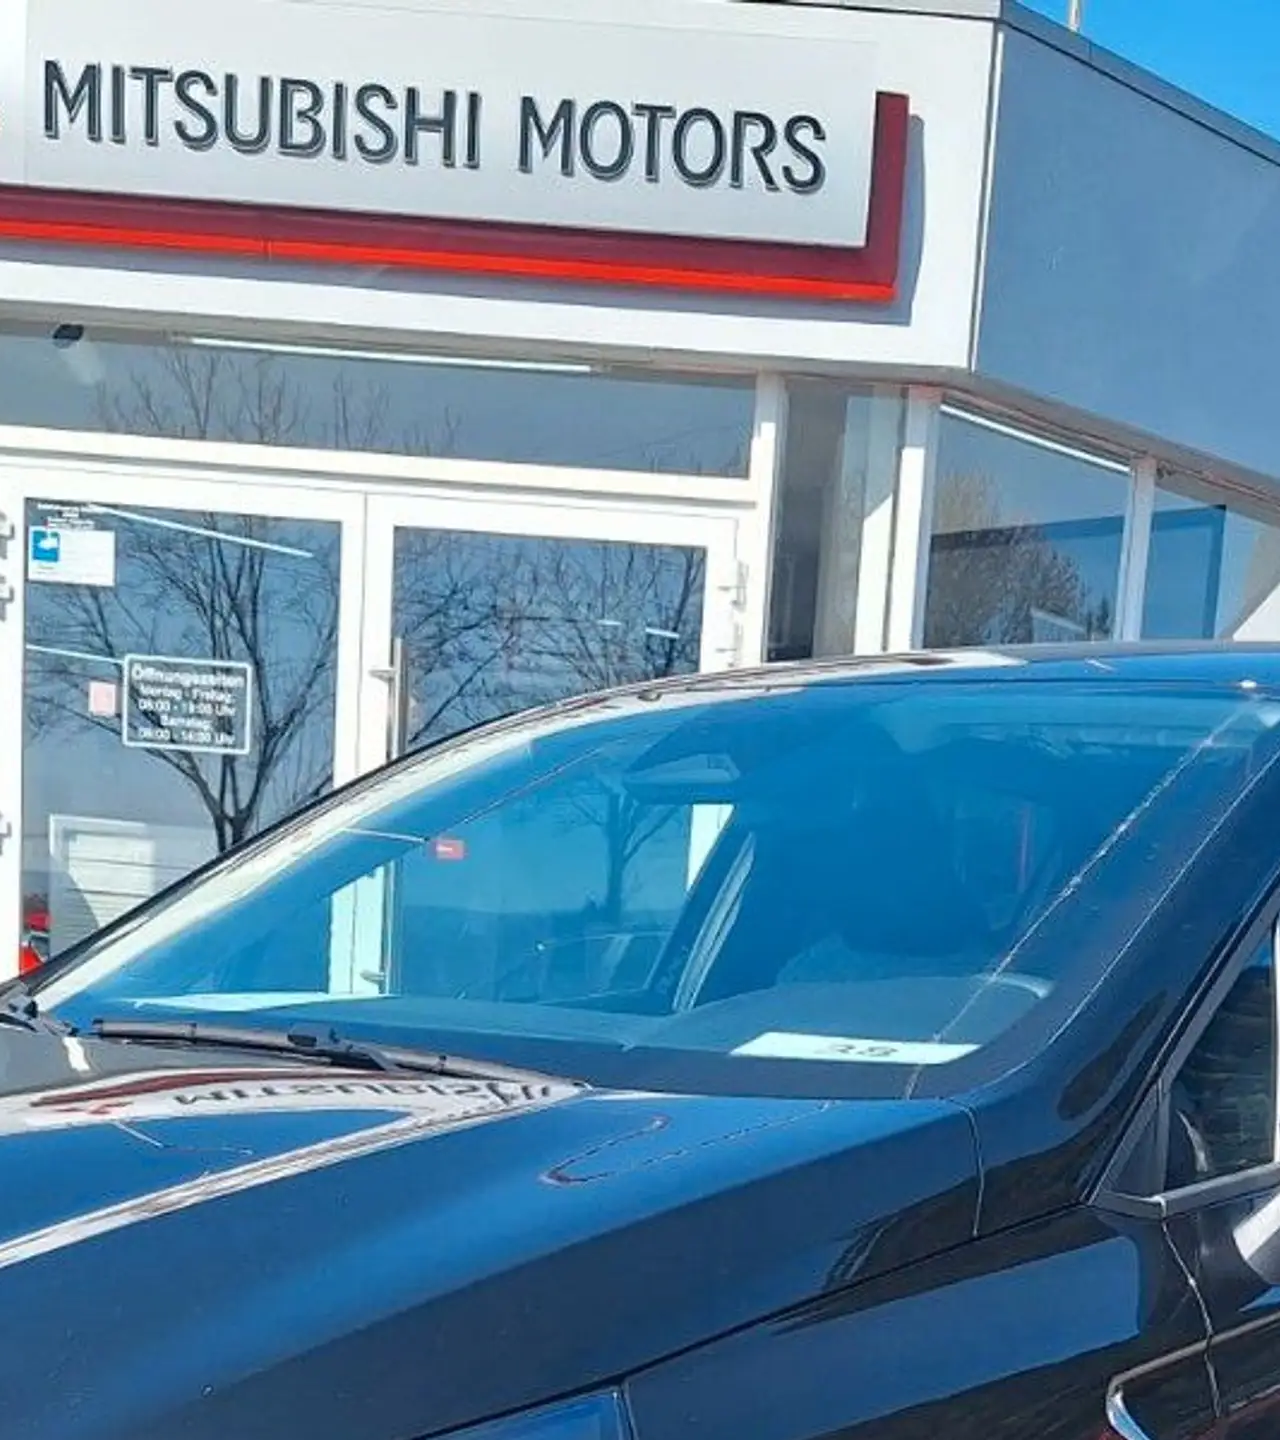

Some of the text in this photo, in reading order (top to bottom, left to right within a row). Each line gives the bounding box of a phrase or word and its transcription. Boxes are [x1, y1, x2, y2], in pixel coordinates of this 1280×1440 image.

[43, 58, 827, 195] MITSUBISHI MOTORS
[131, 662, 245, 689] Öffnungszeiten
